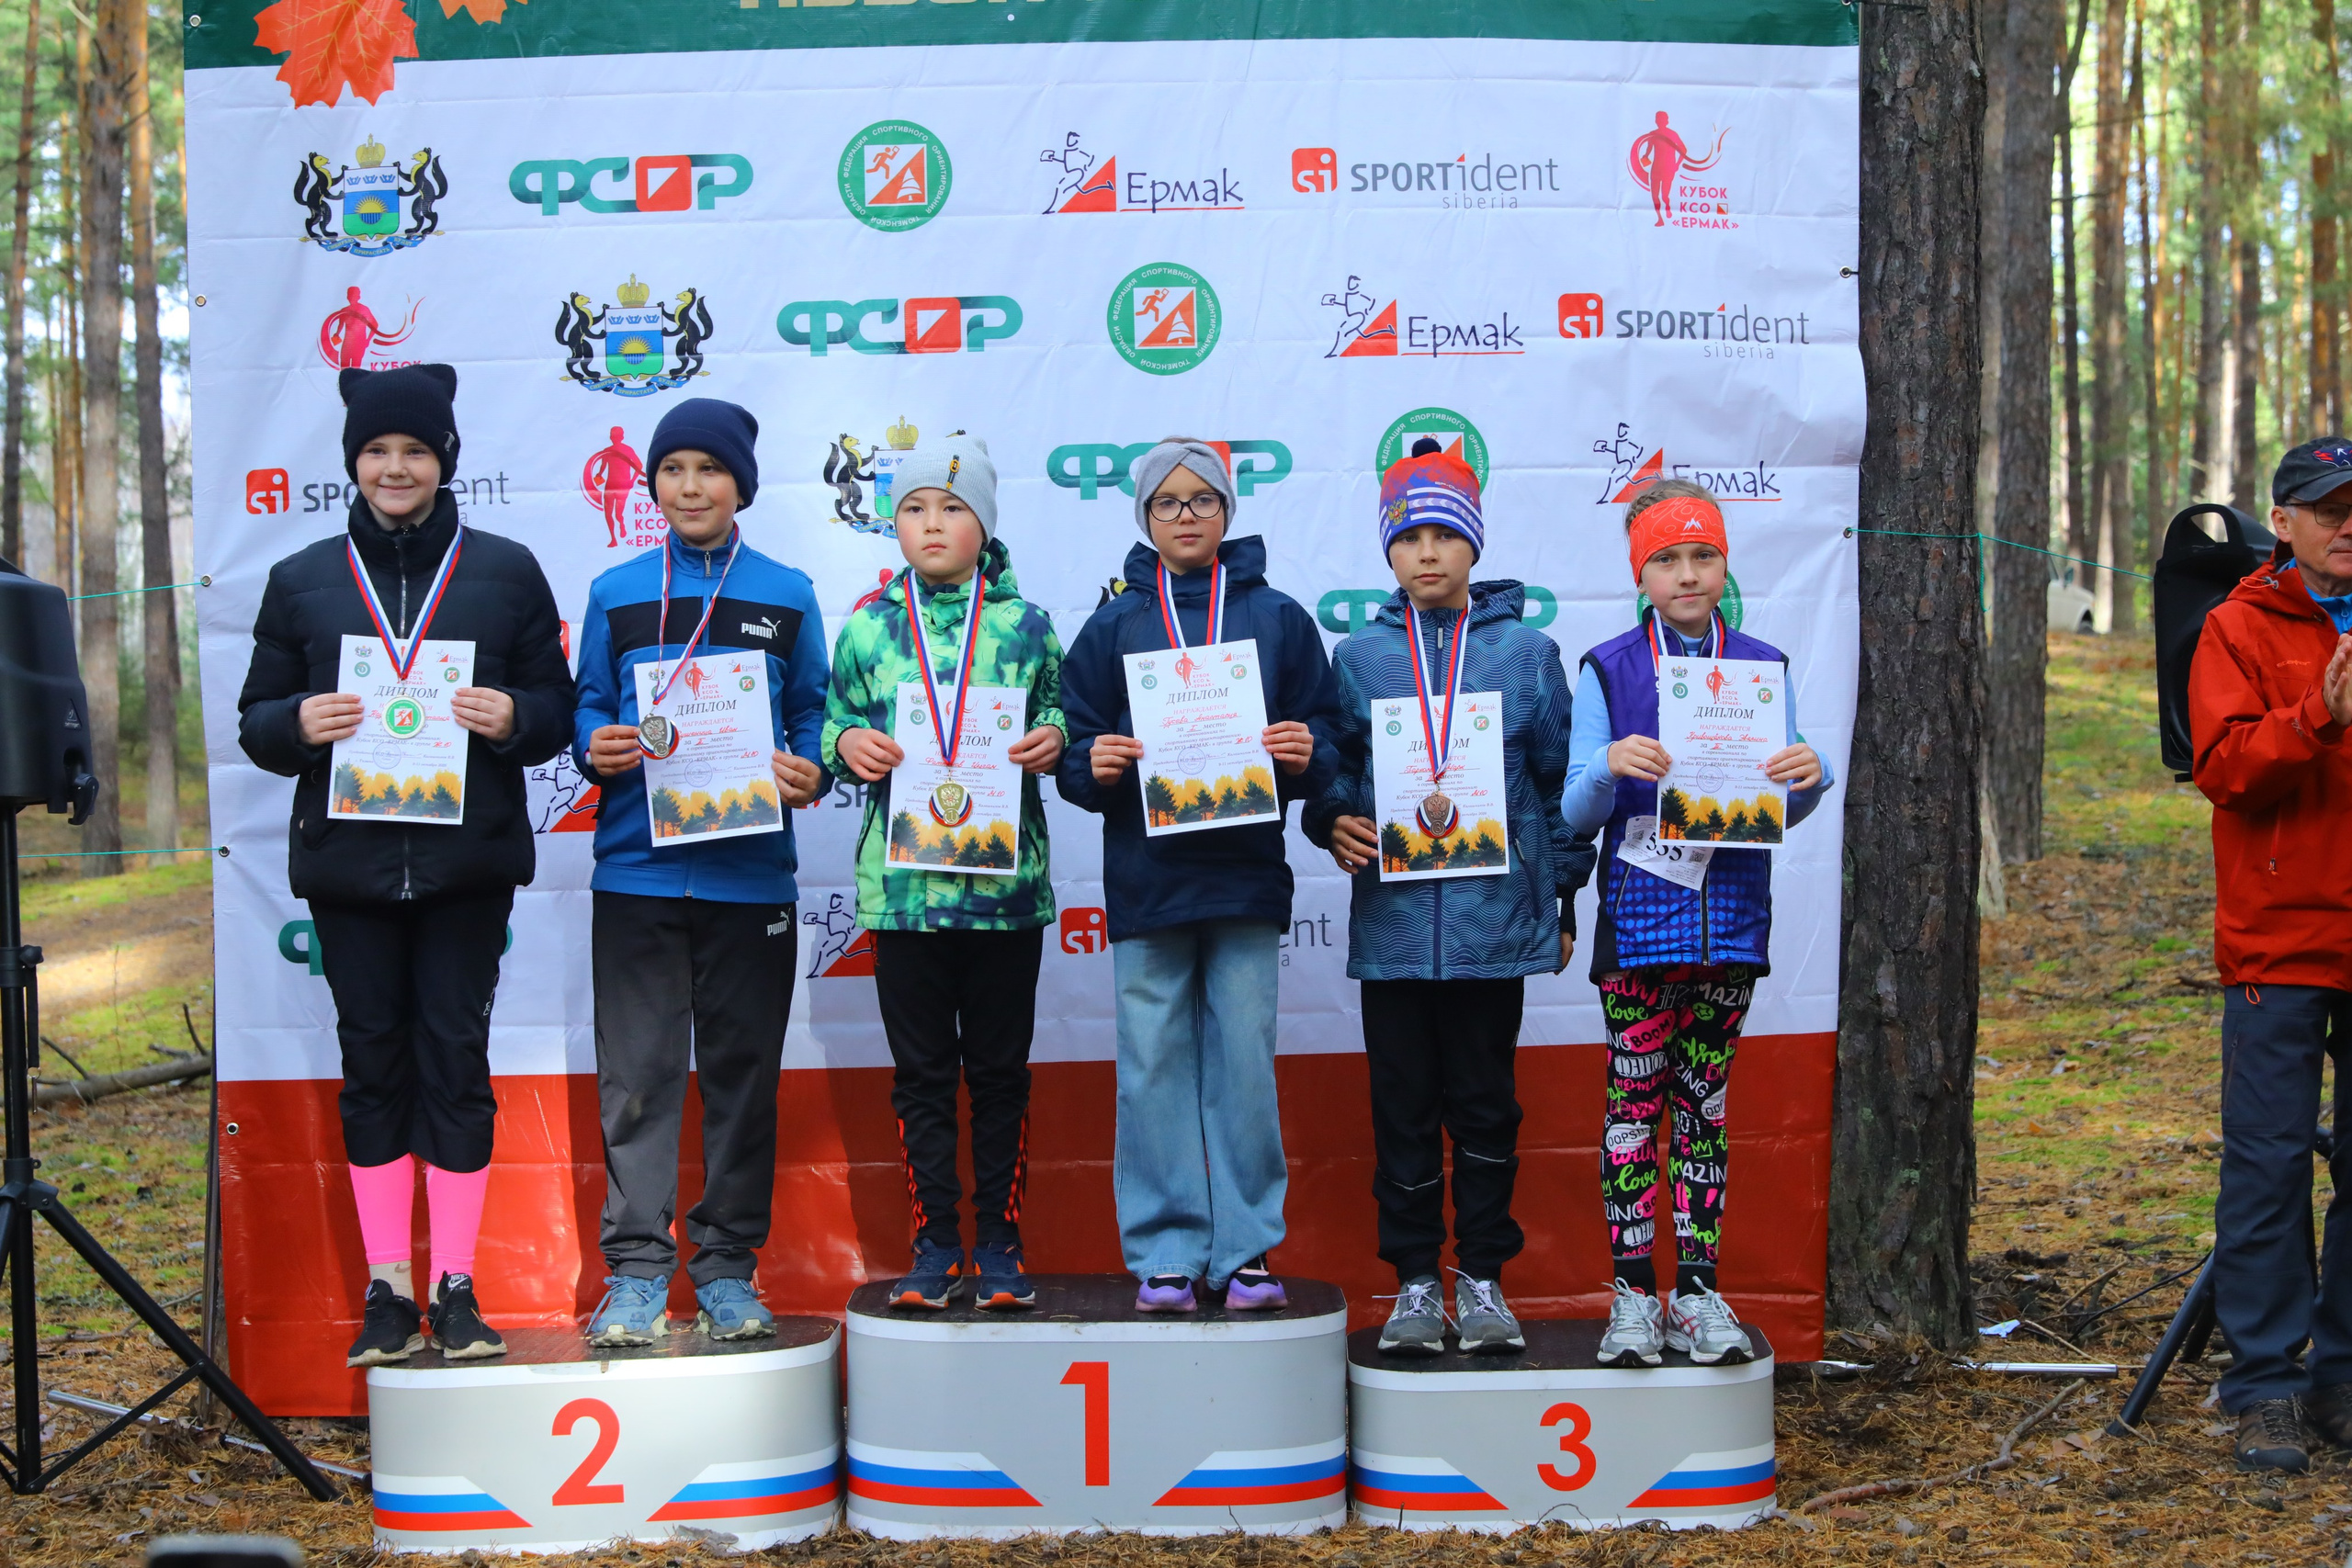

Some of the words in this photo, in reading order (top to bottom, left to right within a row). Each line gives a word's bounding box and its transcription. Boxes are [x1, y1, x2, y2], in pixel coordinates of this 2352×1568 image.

[872, 125, 929, 141] СПОРТИВНОГО
[843, 135, 868, 178] ФЕДЕРАЦИЯ
[925, 145, 946, 214] ОРИЕНТИРОВАНИЯ
[1351, 152, 1560, 192] SPORTident
[1127, 168, 1244, 213] Ермак
[1679, 186, 1727, 199] КУБОК
[843, 183, 866, 216] ОБЛАСТИ
[1442, 193, 1518, 209] siberia
[1679, 202, 1711, 213] КСО
[871, 216, 921, 227] ТЮМЕНСКОЙ
[1672, 217, 1739, 230] «ЕРМАК»
[1141, 267, 1197, 285] СПОРТИВНОГО
[1113, 277, 1137, 321] ФЕДЕРАЦИЯ
[1195, 288, 1216, 357] ОРИЕНТИРОВАНИЯ
[1616, 302, 1810, 344] SPORTident
[1114, 326, 1136, 358] ОБЛАСТИ
[1408, 312, 1523, 358] Ермак
[1703, 343, 1774, 359] siberia
[1140, 359, 1191, 370] ТЮМЕНСКОЙ
[1382, 423, 1407, 466] ФЕДЕРАЦИЯ
[1410, 412, 1465, 430] СПОРТИВНОГО
[1468, 434, 1484, 484] ОРИЕНТИРО
[635, 518, 668, 530] КСО
[741, 623, 772, 639] PUMA
[374, 685, 439, 698] ДИПЛОМ
[1166, 687, 1229, 705] ДИПЛОМ
[674, 700, 737, 717] ДИПЛОМ
[1173, 705, 1227, 715] НАГРАЖДАЕТСЯ
[1693, 706, 1754, 719] ДИПЛОМ
[682, 717, 734, 728] НАГРАЖДАЕТСЯ
[1700, 724, 1751, 732] НАГРАЖДАЕТСЯ
[930, 733, 992, 747] ДЛОМ
[767, 920, 787, 936] PUMA
[1606, 993, 1648, 1021] love
[1614, 1164, 1657, 1191] love
[1060, 1361, 1110, 1485] 1
[552, 1398, 625, 1506] 2
[1537, 1403, 1596, 1492] 3
